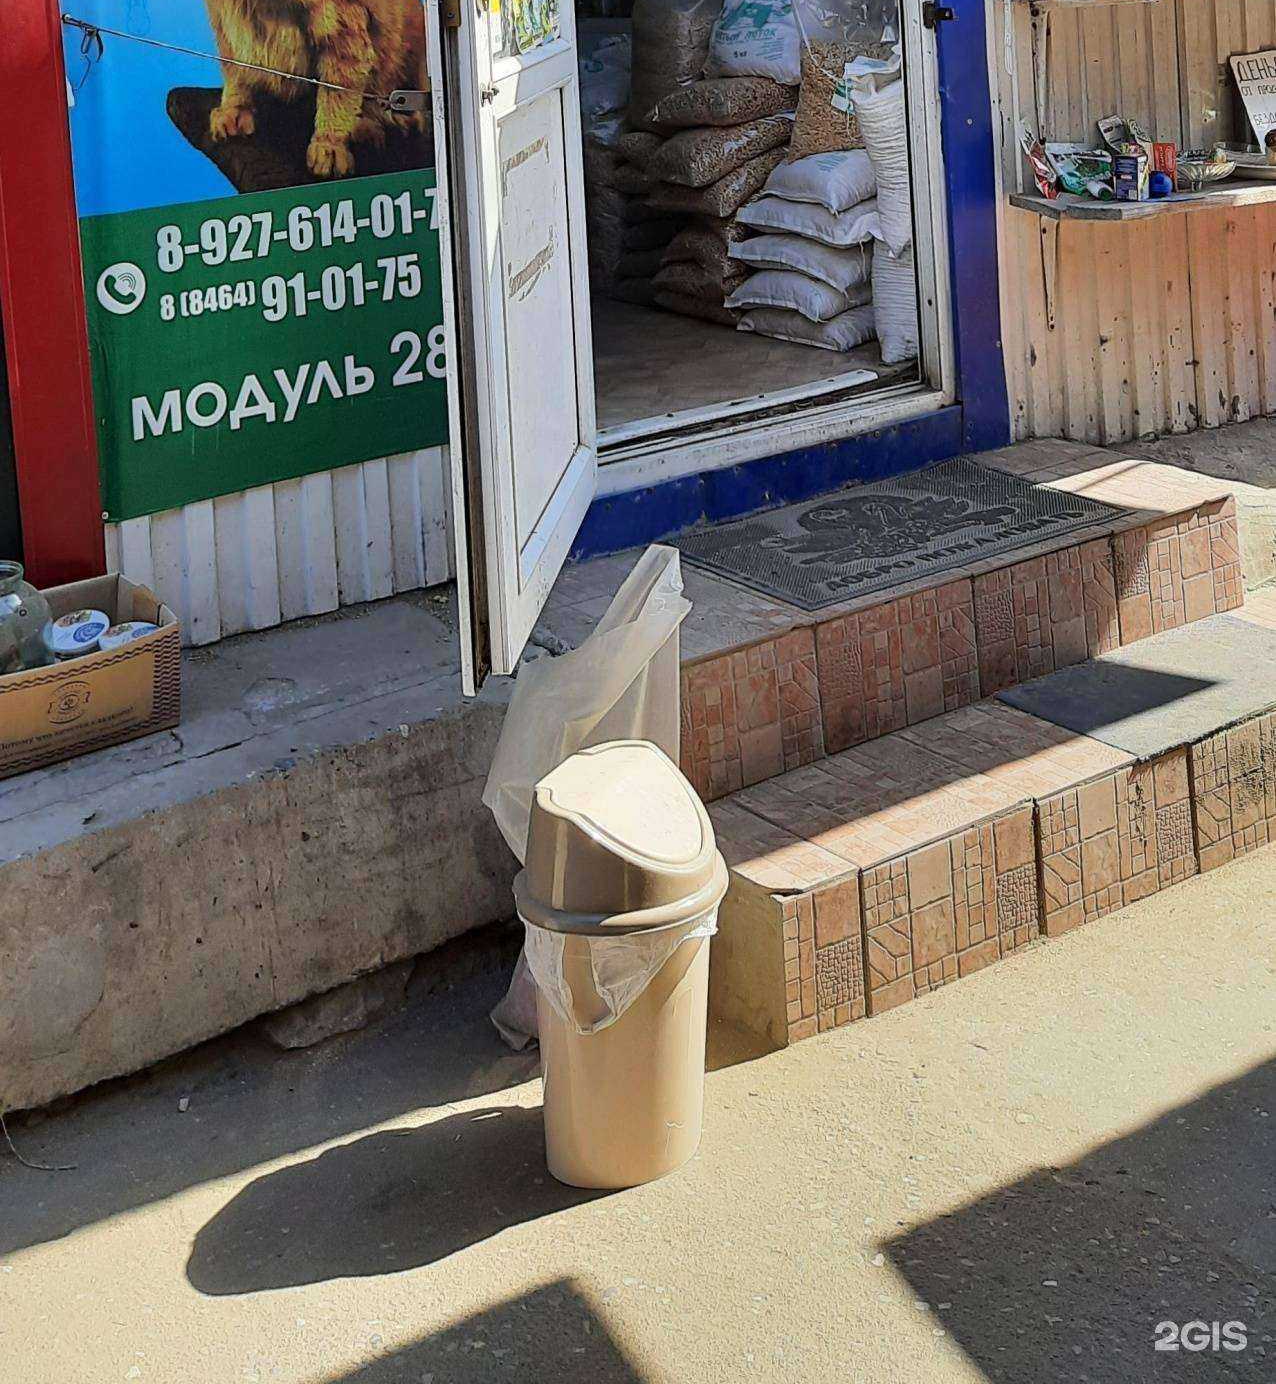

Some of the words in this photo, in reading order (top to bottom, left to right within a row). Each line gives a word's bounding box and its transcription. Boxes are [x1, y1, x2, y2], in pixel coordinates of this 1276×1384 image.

[159, 294, 176, 321] 8
[180, 280, 256, 318] (8464)
[261, 253, 422, 322] 91-01-75
[131, 354, 375, 442] МОДУЛЬ
[826, 560, 915, 592] ДОБРО
[915, 511, 1085, 562] ПОЖАЛОВАТЬ
